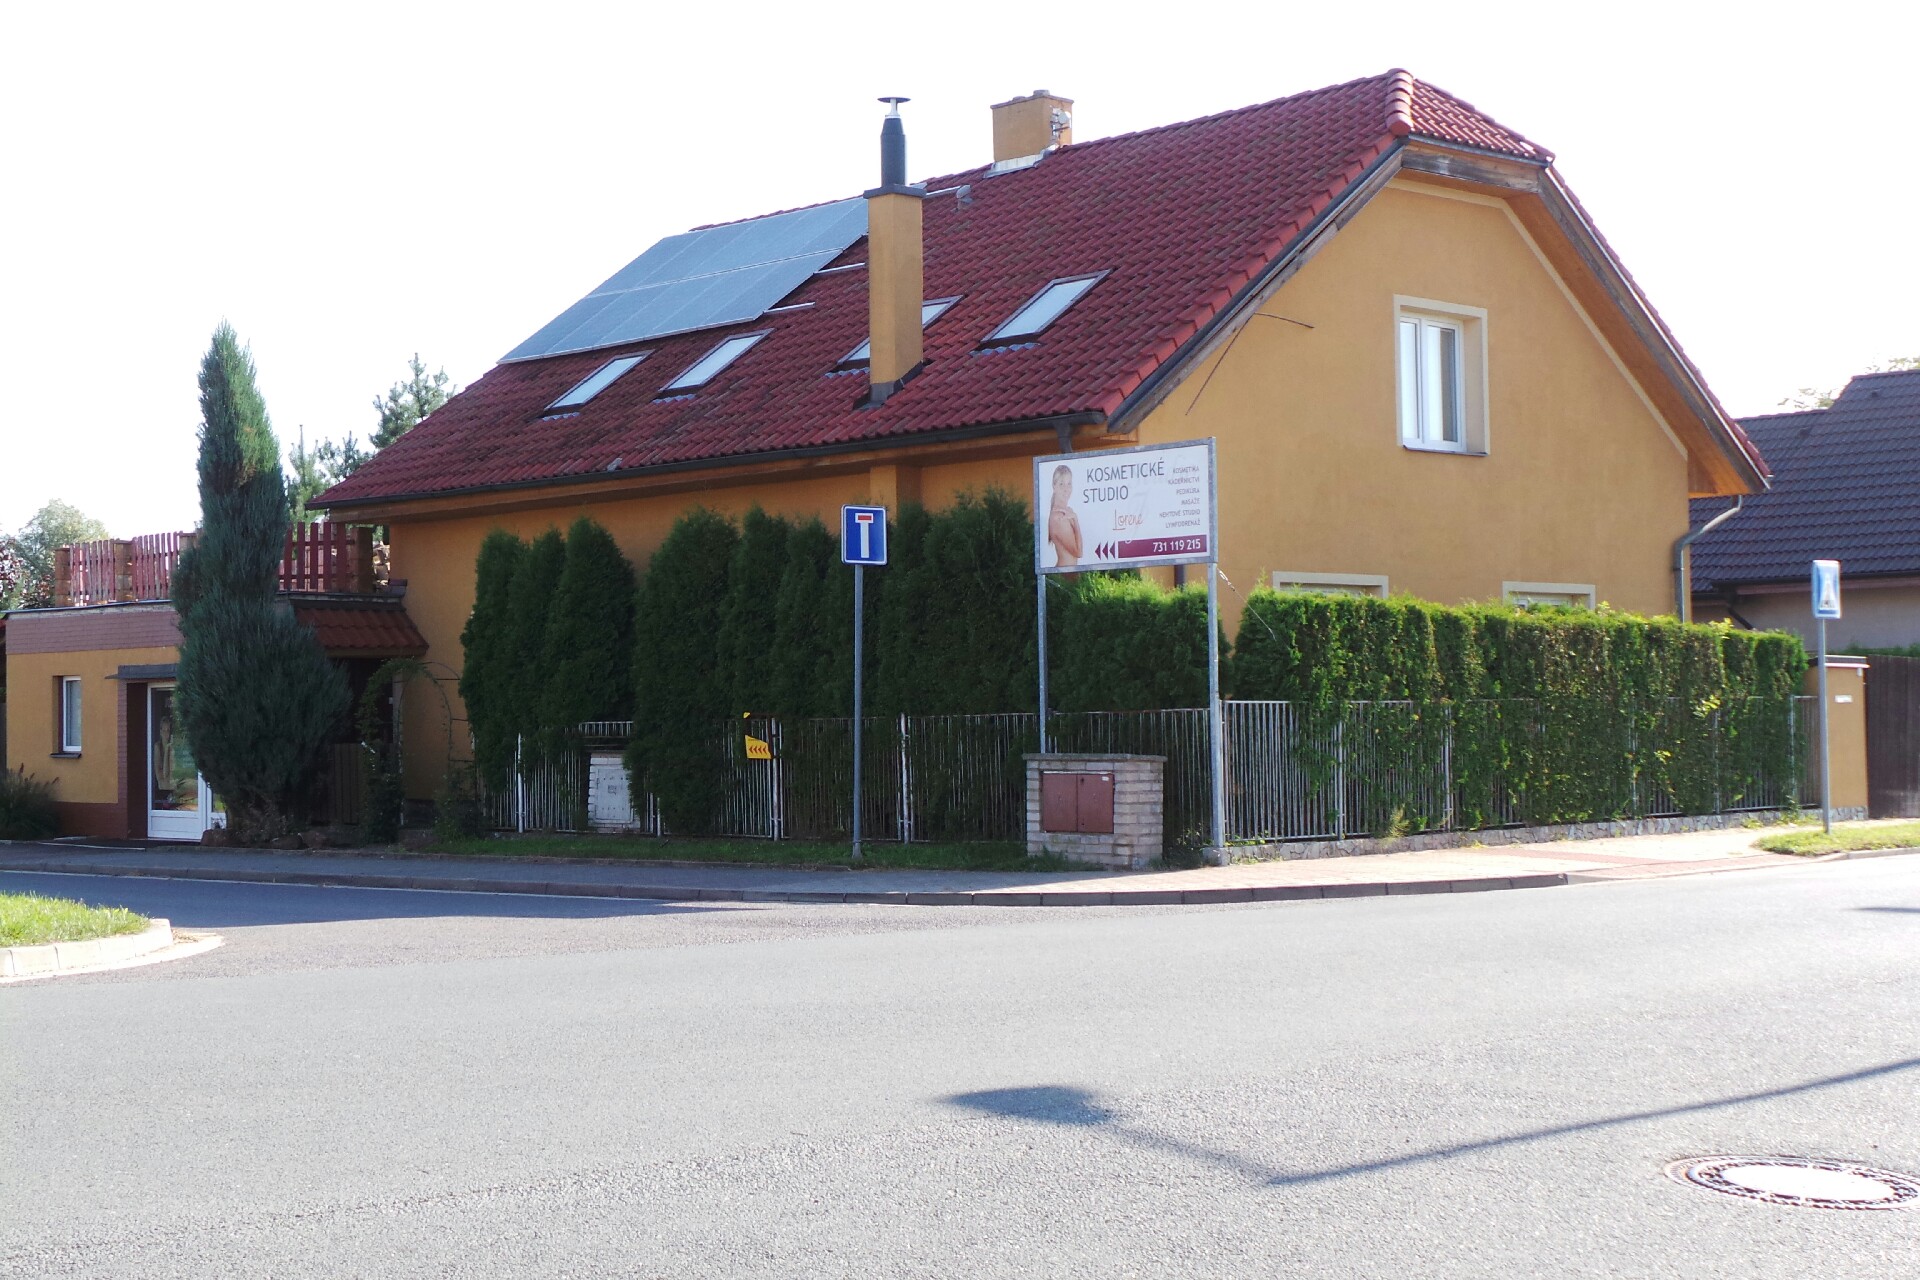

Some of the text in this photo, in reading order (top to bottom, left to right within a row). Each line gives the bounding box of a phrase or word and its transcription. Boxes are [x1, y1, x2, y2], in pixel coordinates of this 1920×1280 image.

[1087, 457, 1164, 483] KOSMETICKÉ
[1083, 485, 1129, 504] STUDIO
[1182, 508, 1201, 517] STUDIO
[1153, 538, 1201, 553] 731 119 215
